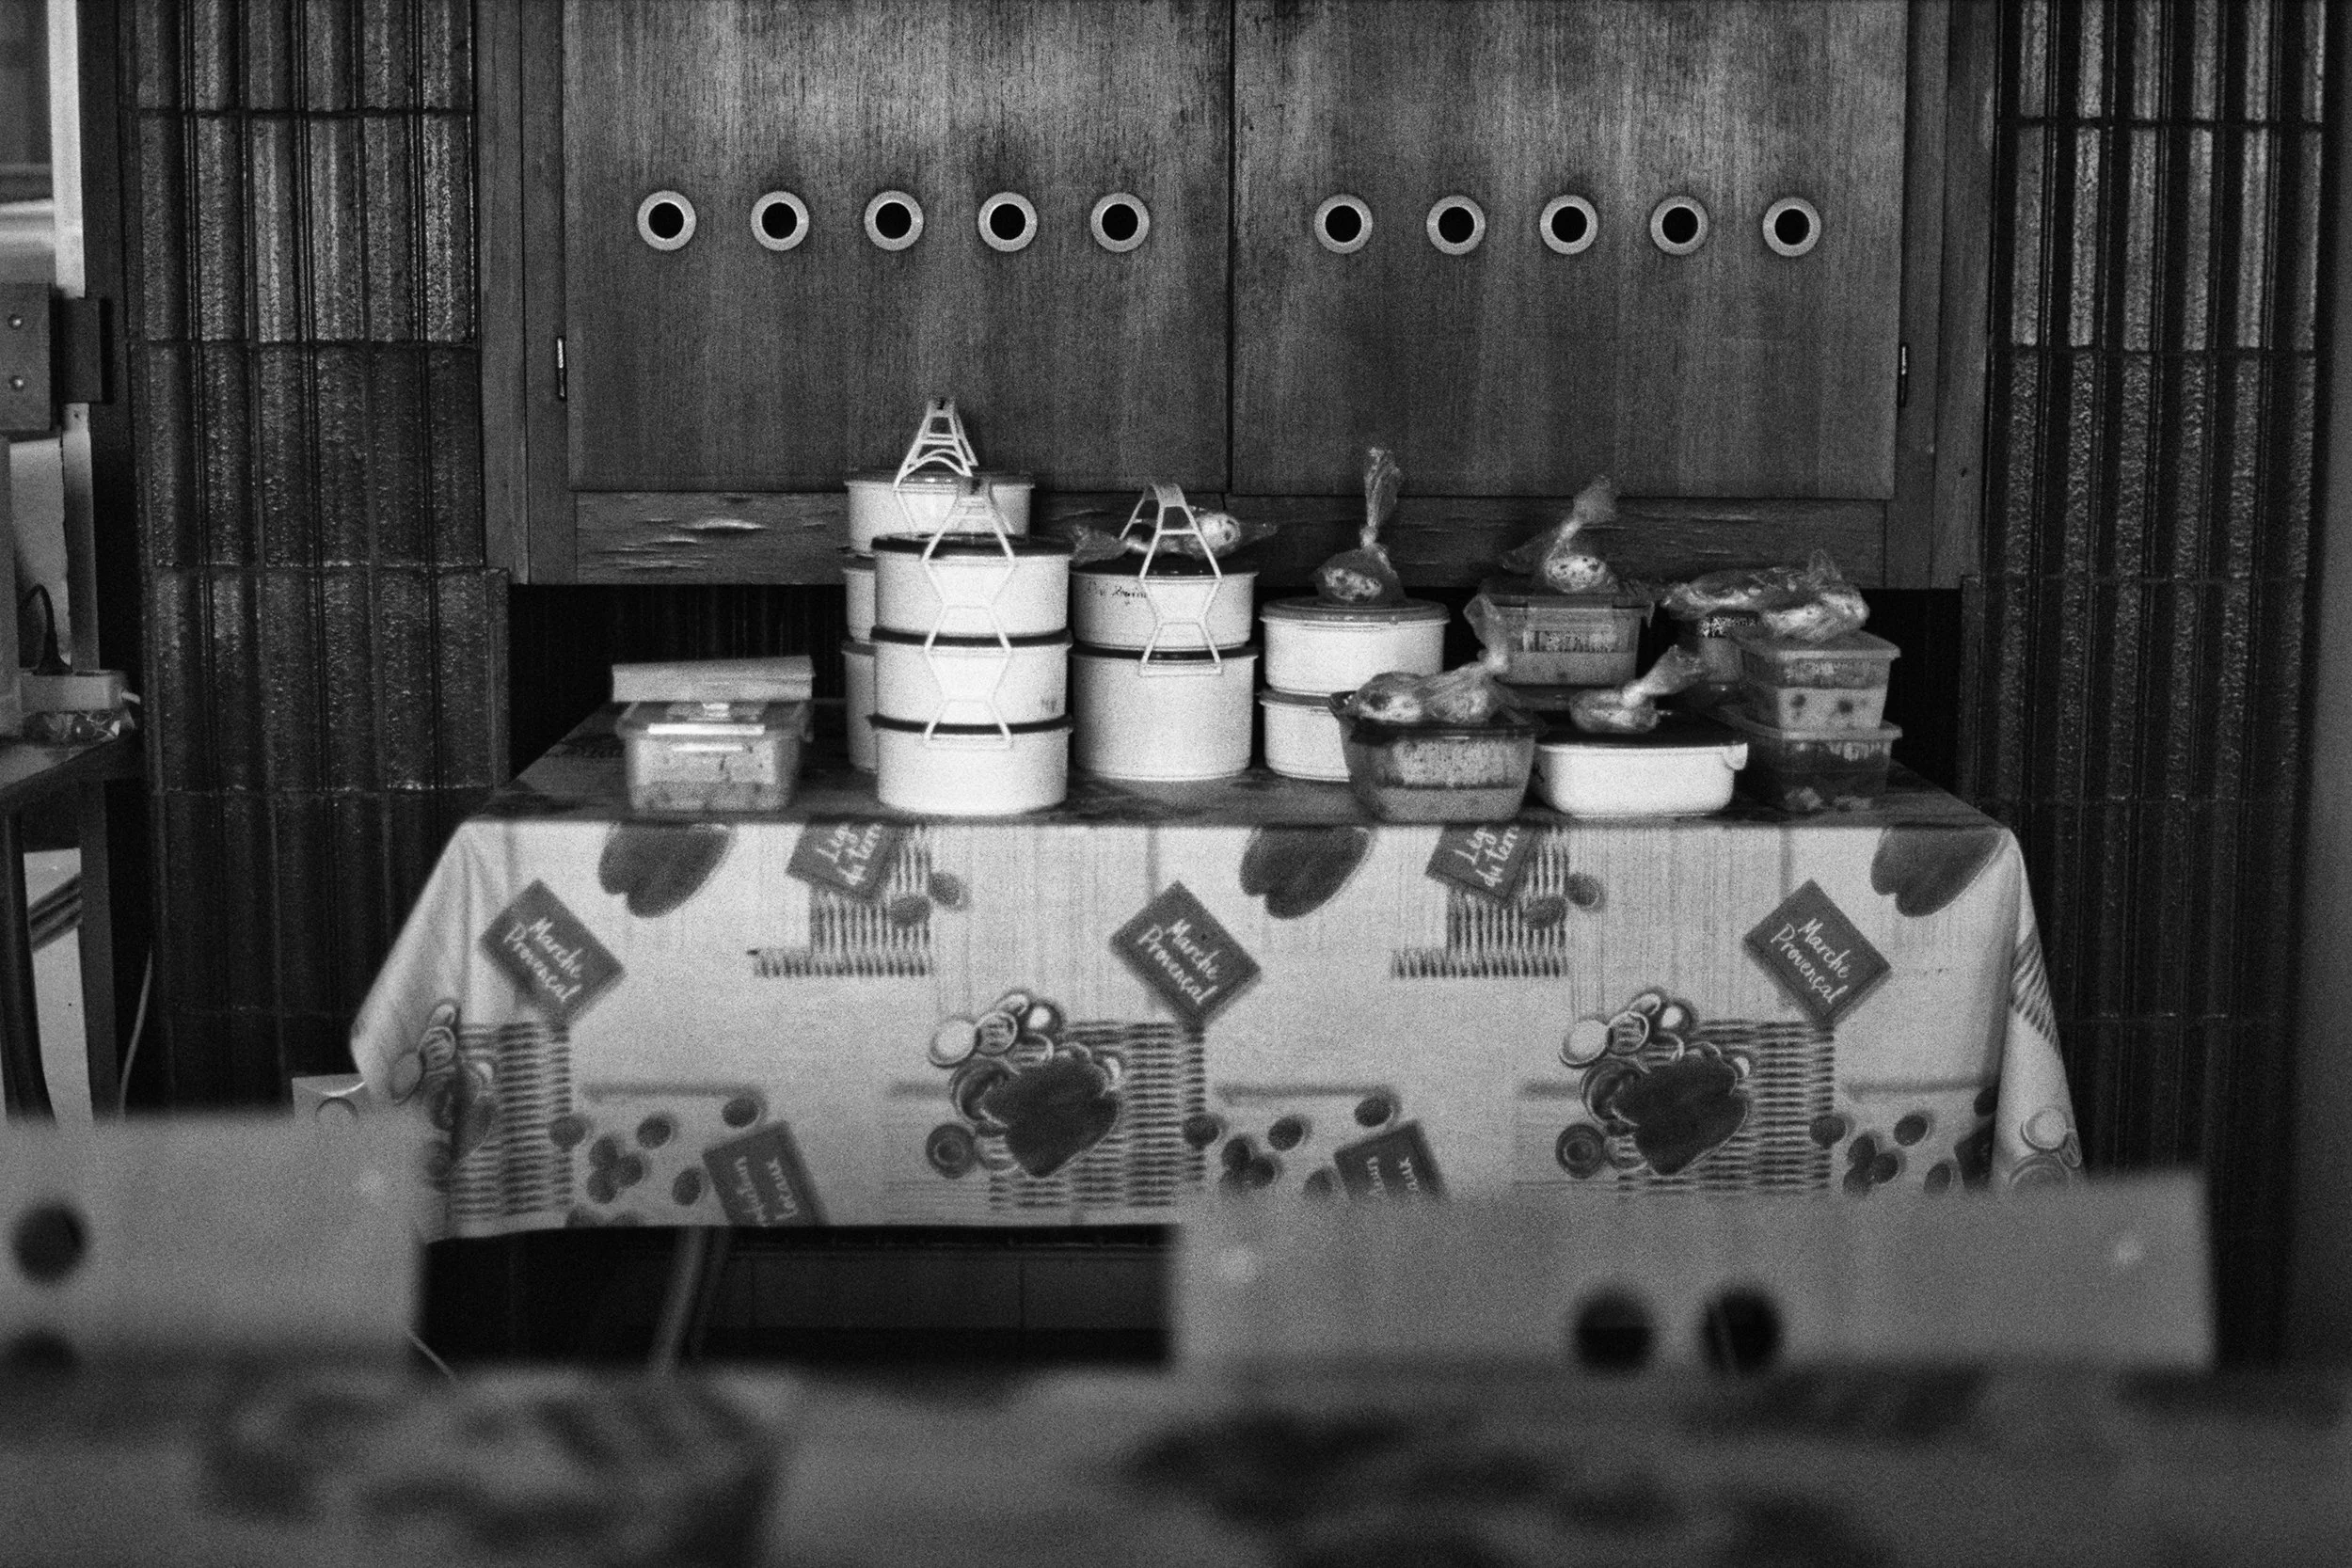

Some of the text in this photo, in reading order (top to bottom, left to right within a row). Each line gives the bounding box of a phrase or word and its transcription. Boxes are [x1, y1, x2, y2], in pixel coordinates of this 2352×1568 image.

[1475, 864, 1503, 887] du
[1137, 924, 1219, 1006] Provençal
[1770, 923, 1849, 1005] Provençal
